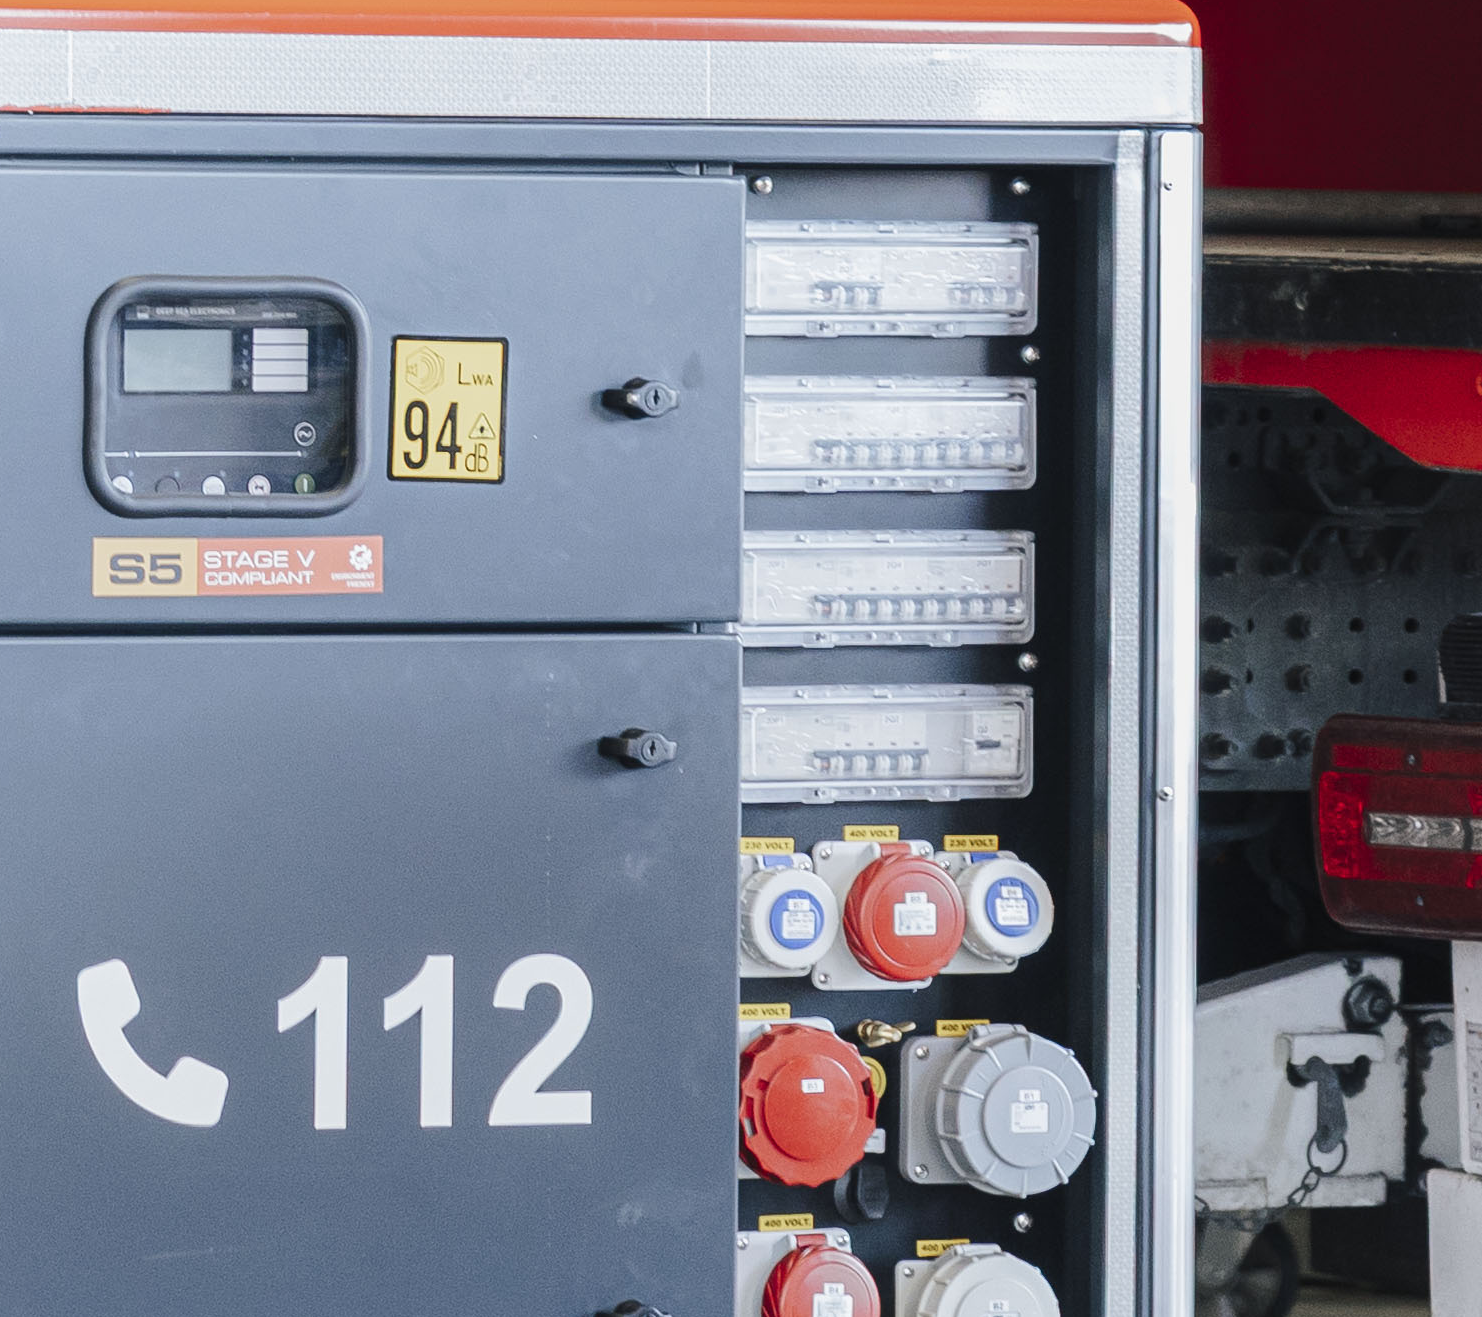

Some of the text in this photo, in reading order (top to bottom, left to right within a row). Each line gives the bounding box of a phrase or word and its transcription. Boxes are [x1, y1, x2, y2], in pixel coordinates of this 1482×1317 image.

[403, 400, 489, 473] 94 dB
[108, 549, 316, 585] S5 STAGE V
[204, 570, 314, 587] COMPLIANT
[849, 829, 866, 837] 400
[744, 841, 762, 850] 230
[741, 1008, 758, 1016] 400
[941, 1023, 959, 1031] 400
[278, 953, 594, 1131] 112
[764, 1219, 781, 1228] 400
[921, 1244, 939, 1252] 400
